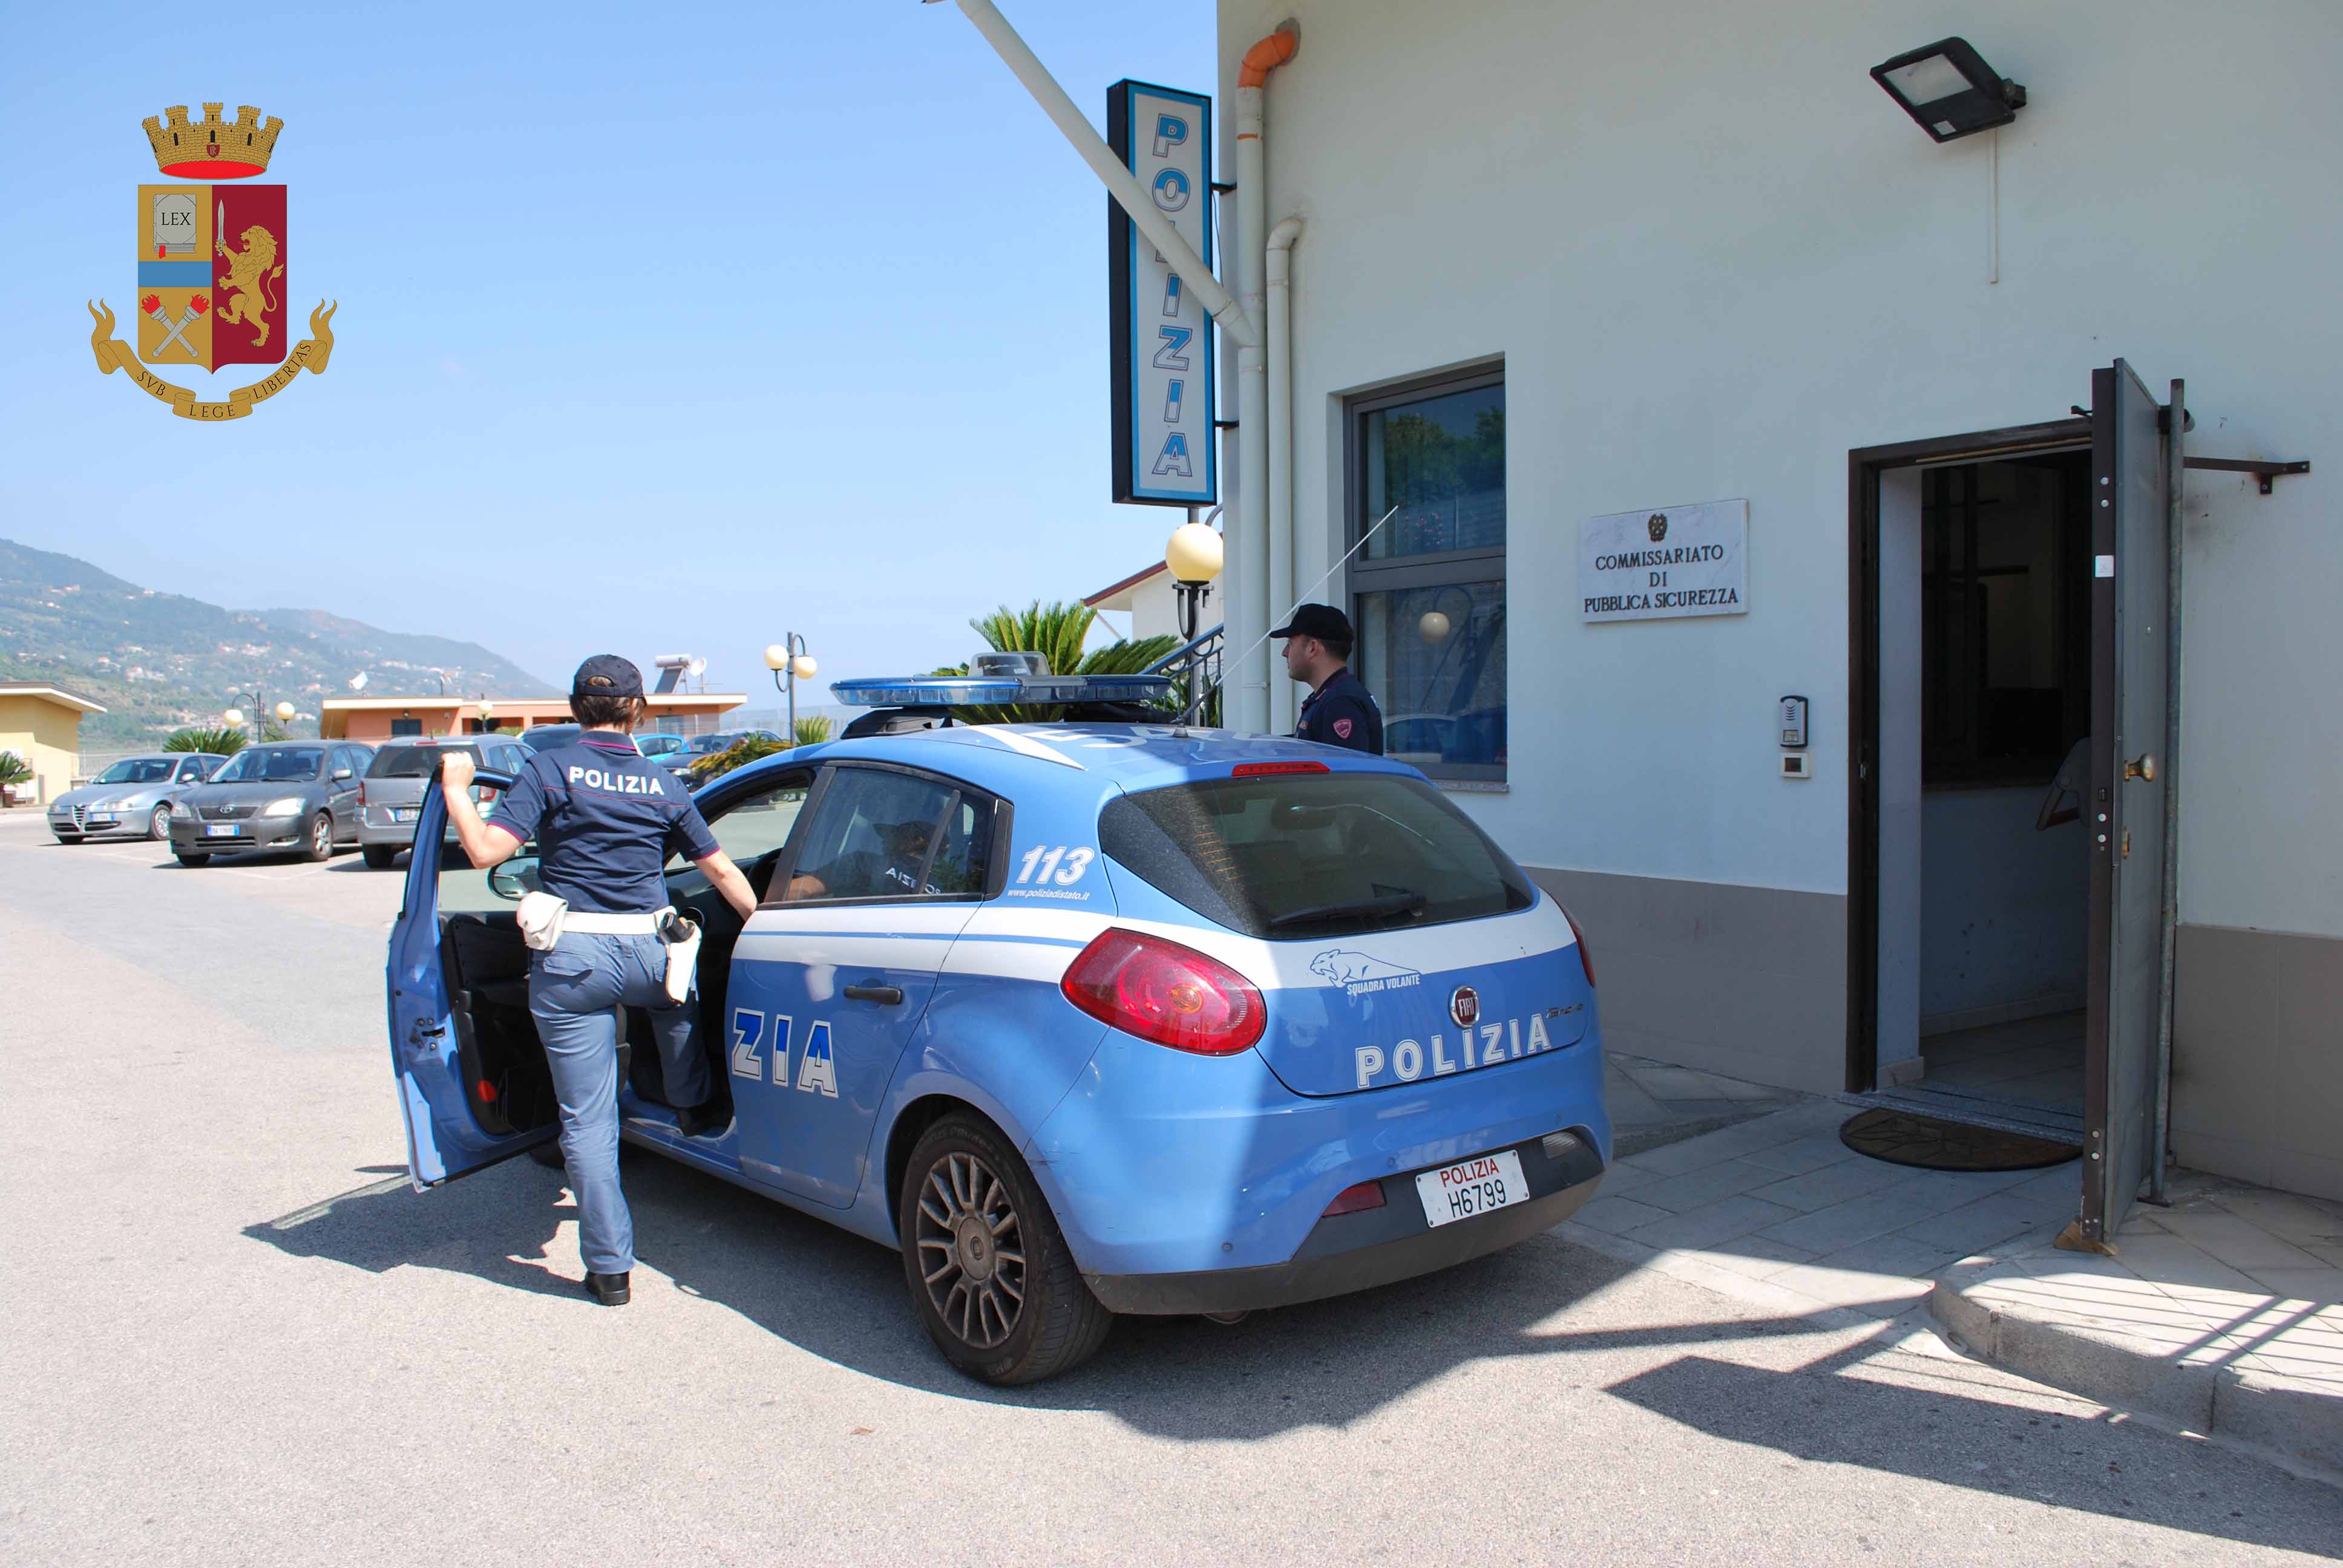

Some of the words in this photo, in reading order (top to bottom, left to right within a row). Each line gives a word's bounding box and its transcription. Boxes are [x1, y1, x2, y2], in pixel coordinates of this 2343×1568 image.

[1595, 544, 1723, 570] COMMISSARIATO
[1649, 572, 1667, 587] DI
[1584, 593, 1651, 613] PUBBLICA
[1654, 588, 1738, 609] SICUREZZA
[569, 766, 664, 795] POLIZIA
[1016, 845, 1095, 886] 113
[1007, 889, 1090, 901] www.poliziadistato.it
[1347, 980, 1384, 996] SQUADRA
[1386, 974, 1420, 989] VOLANTE
[1458, 997, 1475, 1017] FIAT
[1355, 1013, 1552, 1088] POLIZIA
[1439, 1158, 1500, 1187] POLIZIA
[1447, 1179, 1506, 1218] H6799
